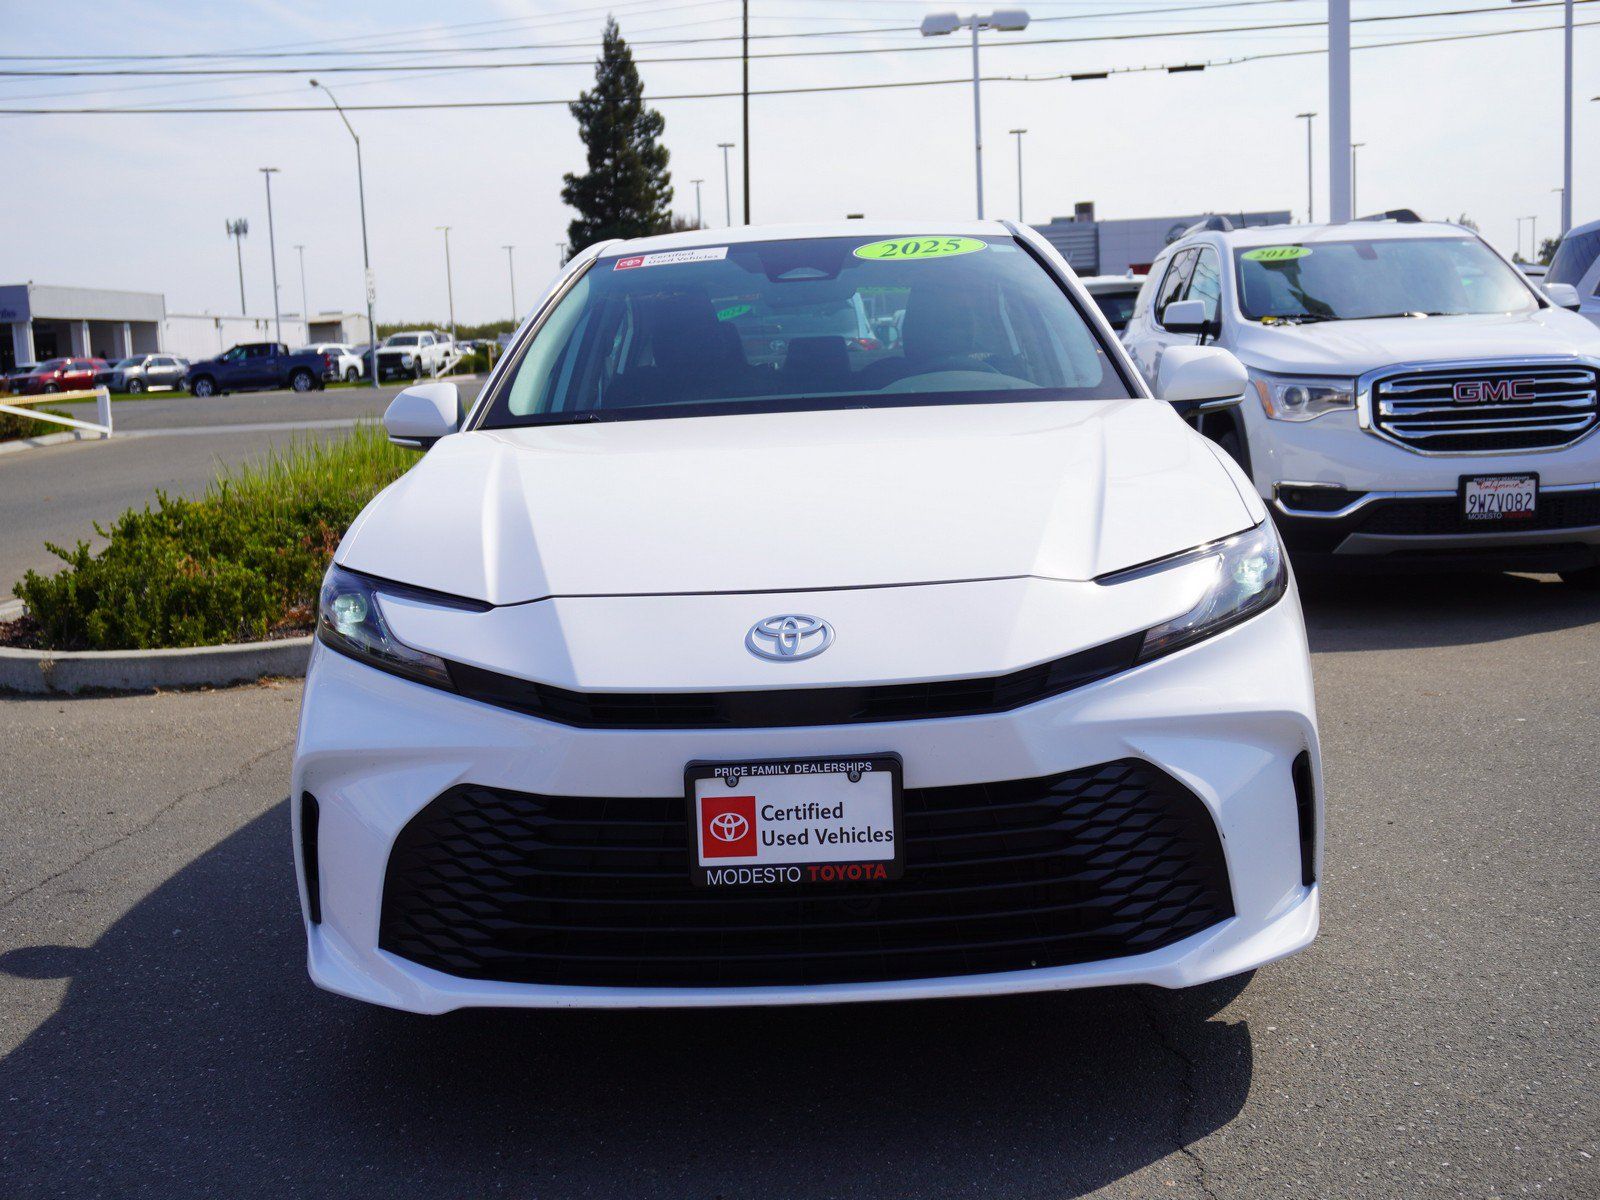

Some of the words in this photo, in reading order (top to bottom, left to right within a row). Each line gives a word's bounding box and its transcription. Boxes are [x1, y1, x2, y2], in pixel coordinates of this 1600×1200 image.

[650, 251, 695, 259] Certified
[879, 238, 962, 257] 2025
[1254, 248, 1299, 258] 2019
[677, 254, 719, 262] Vehicles
[1453, 378, 1536, 403] GMC
[1469, 492, 1533, 513] 9WZV082
[1468, 511, 1503, 520] MODESTO
[714, 766, 748, 777] PRICE
[751, 764, 791, 775] FAMILY
[794, 762, 873, 774] DEALERSHIPS
[761, 801, 844, 822] Certified
[762, 829, 809, 847] Used
[814, 826, 894, 845] Vehicles
[706, 866, 801, 886] MODESTO
[806, 863, 888, 882] TOYOTA
